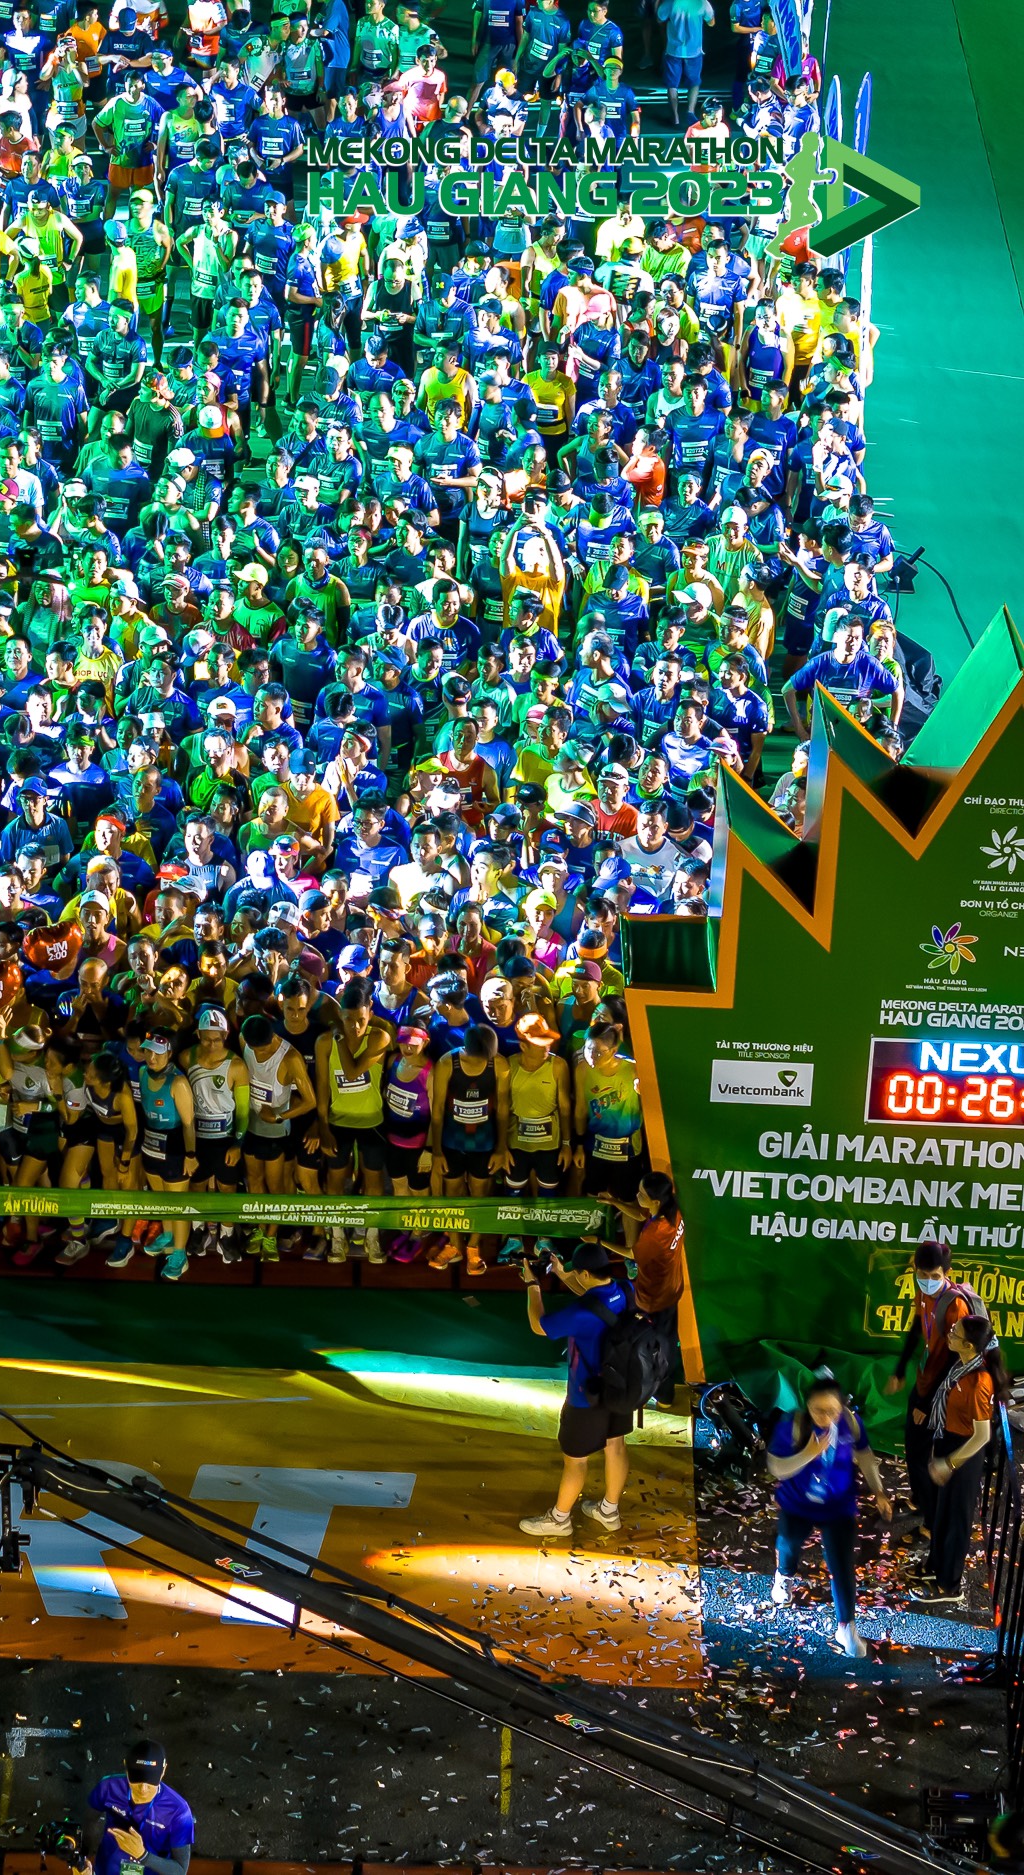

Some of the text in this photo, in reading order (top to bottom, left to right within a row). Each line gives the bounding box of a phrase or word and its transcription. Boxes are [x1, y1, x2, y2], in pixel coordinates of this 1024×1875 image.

[46, 940, 68, 955] HM
[48, 950, 68, 961] 2:00
[881, 1000, 936, 1011] MEKONG
[938, 1002, 978, 1013] DELTA
[879, 1010, 923, 1026] HAU
[926, 1012, 991, 1029] GIANG
[738, 1050, 755, 1058] TITLE
[717, 1082, 805, 1098] Vietcombank
[758, 1123, 828, 1160] GIẢI
[433, 1216, 470, 1230] GIANG
[522, 1213, 558, 1223] GIANG
[559, 1214, 590, 1224] 2023
[750, 1211, 808, 1243] HẬU
[811, 1218, 897, 1241] GIANG
[900, 1214, 959, 1246] LẦN
